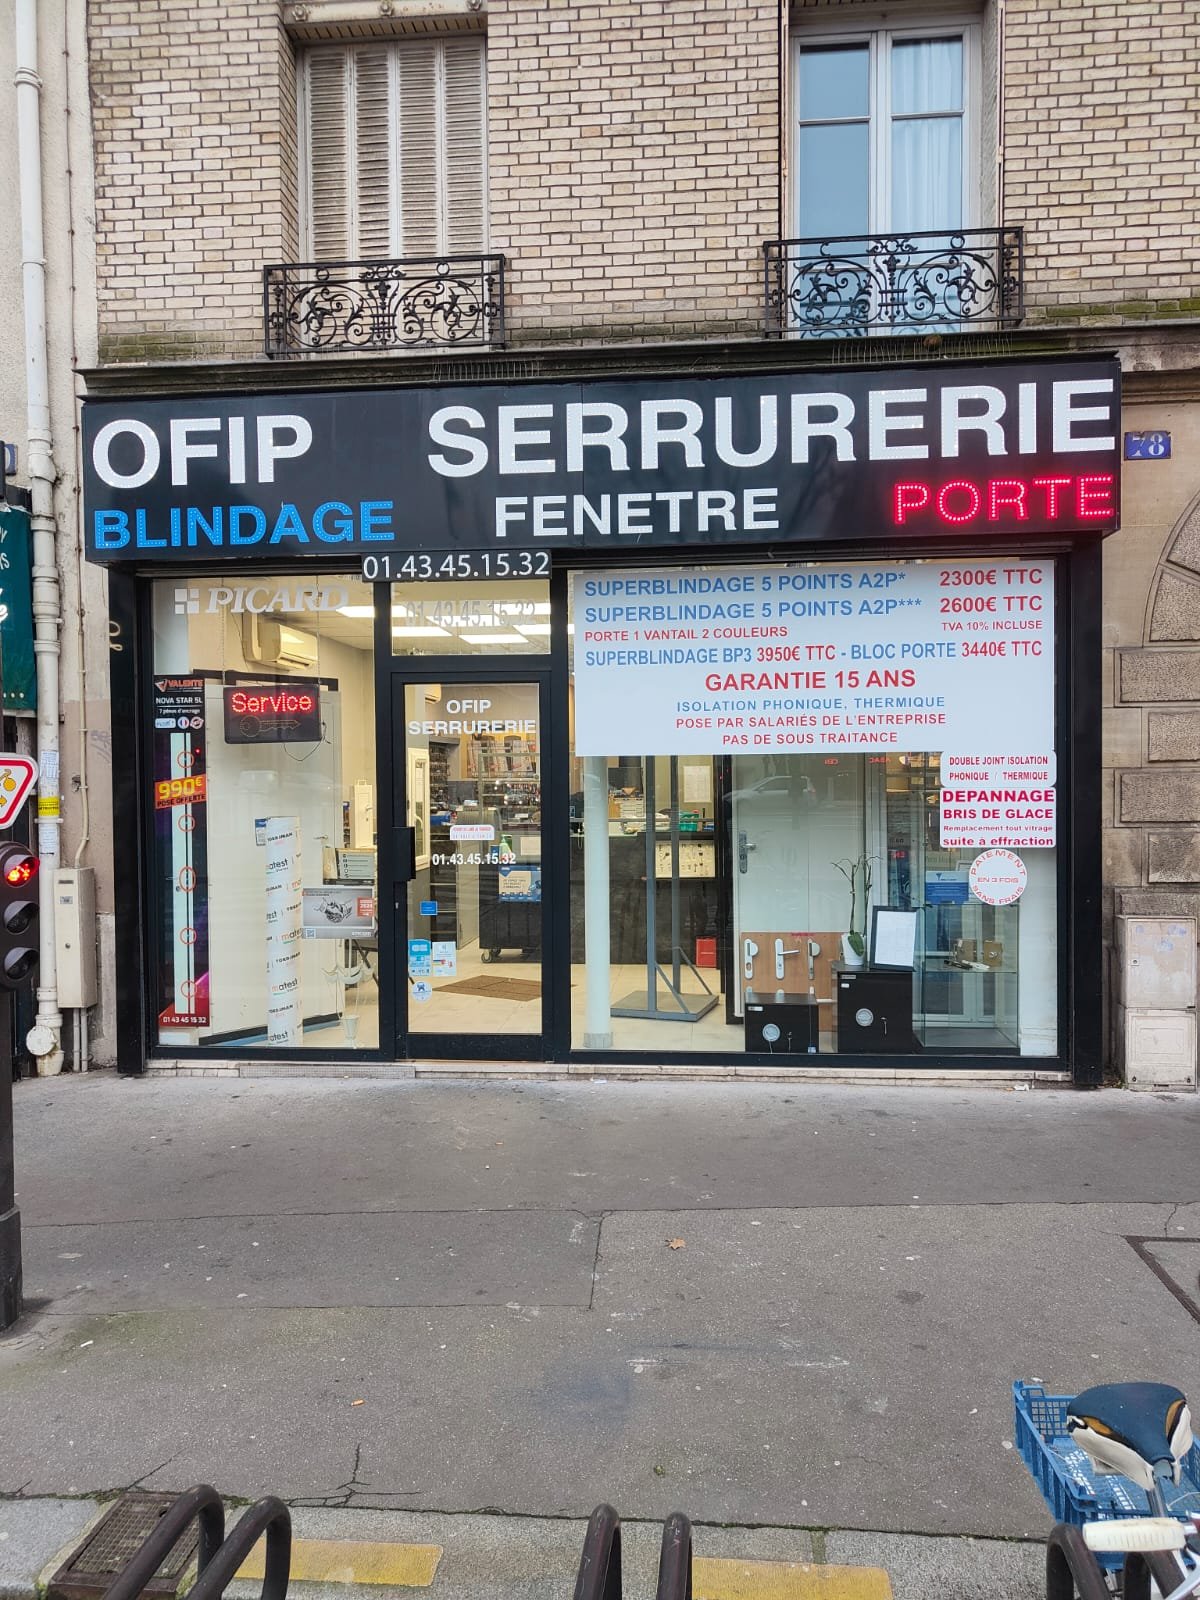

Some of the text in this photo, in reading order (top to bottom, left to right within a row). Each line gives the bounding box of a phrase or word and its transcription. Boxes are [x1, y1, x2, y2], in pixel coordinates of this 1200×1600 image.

[93, 378, 1115, 489] OFIP SERRURERIE
[94, 475, 1114, 549] BLINDAGE FENETRE PORTE
[362, 552, 550, 580] 01.43.45.15.32
[584, 576, 755, 597] SUPERBLINDAGE
[761, 576, 772, 592] 5
[778, 573, 852, 591] POINTS
[939, 570, 997, 587] 2300€
[1003, 568, 1043, 585] TTC
[205, 584, 349, 614] PICARD
[584, 602, 755, 623] SUPERBLINDAGE
[761, 602, 772, 618] 5
[778, 599, 852, 618] POINTS
[939, 597, 997, 614] 2600€
[1003, 595, 1043, 612] TTC
[941, 620, 1043, 631] TVA 10% INCLUSE
[585, 626, 788, 642] PORTE 1 VANTAIL 2 COULEURS
[585, 648, 718, 666] SUPERBLINDAGE
[722, 647, 752, 663] BP3
[756, 645, 800, 663] 3950€
[805, 644, 836, 661] TTC
[851, 643, 896, 660] BLOC
[901, 642, 956, 659] PORTE
[961, 641, 1006, 657] 3440€
[1011, 640, 1043, 656] TTC
[705, 669, 916, 692] GARANTIE 15 ANS
[176, 696, 193, 704] STAR
[231, 691, 313, 713] Service
[446, 699, 492, 714] OFIP
[677, 696, 945, 712] ISOLATION PHONIQUE, THERMIQUE
[408, 719, 537, 735] SERRURERIE
[676, 713, 946, 729] POSE PAR SALARIÉS DE L'ENTREPRISE
[722, 731, 898, 746] PAS DE SOUS TRAITANCE
[949, 756, 1048, 766] DOUBLE JOINT ISOLATION
[949, 772, 989, 781] PHONIQUE
[1003, 771, 1048, 780] THERMIQUE
[158, 776, 203, 800] 990€
[157, 793, 206, 807] POSE OFFERTE
[942, 790, 1054, 803] DEPANNAGE
[943, 808, 1054, 819] BRIS DE GLACE
[943, 837, 974, 846] suite
[990, 836, 1053, 846] effraction
[432, 852, 517, 866] 01.43.45.15.32
[971, 850, 1026, 876] PAIEMENT
[972, 885, 995, 904] SANS
[998, 886, 1024, 904] FRAIS
[198, 1016, 207, 1024] 32
